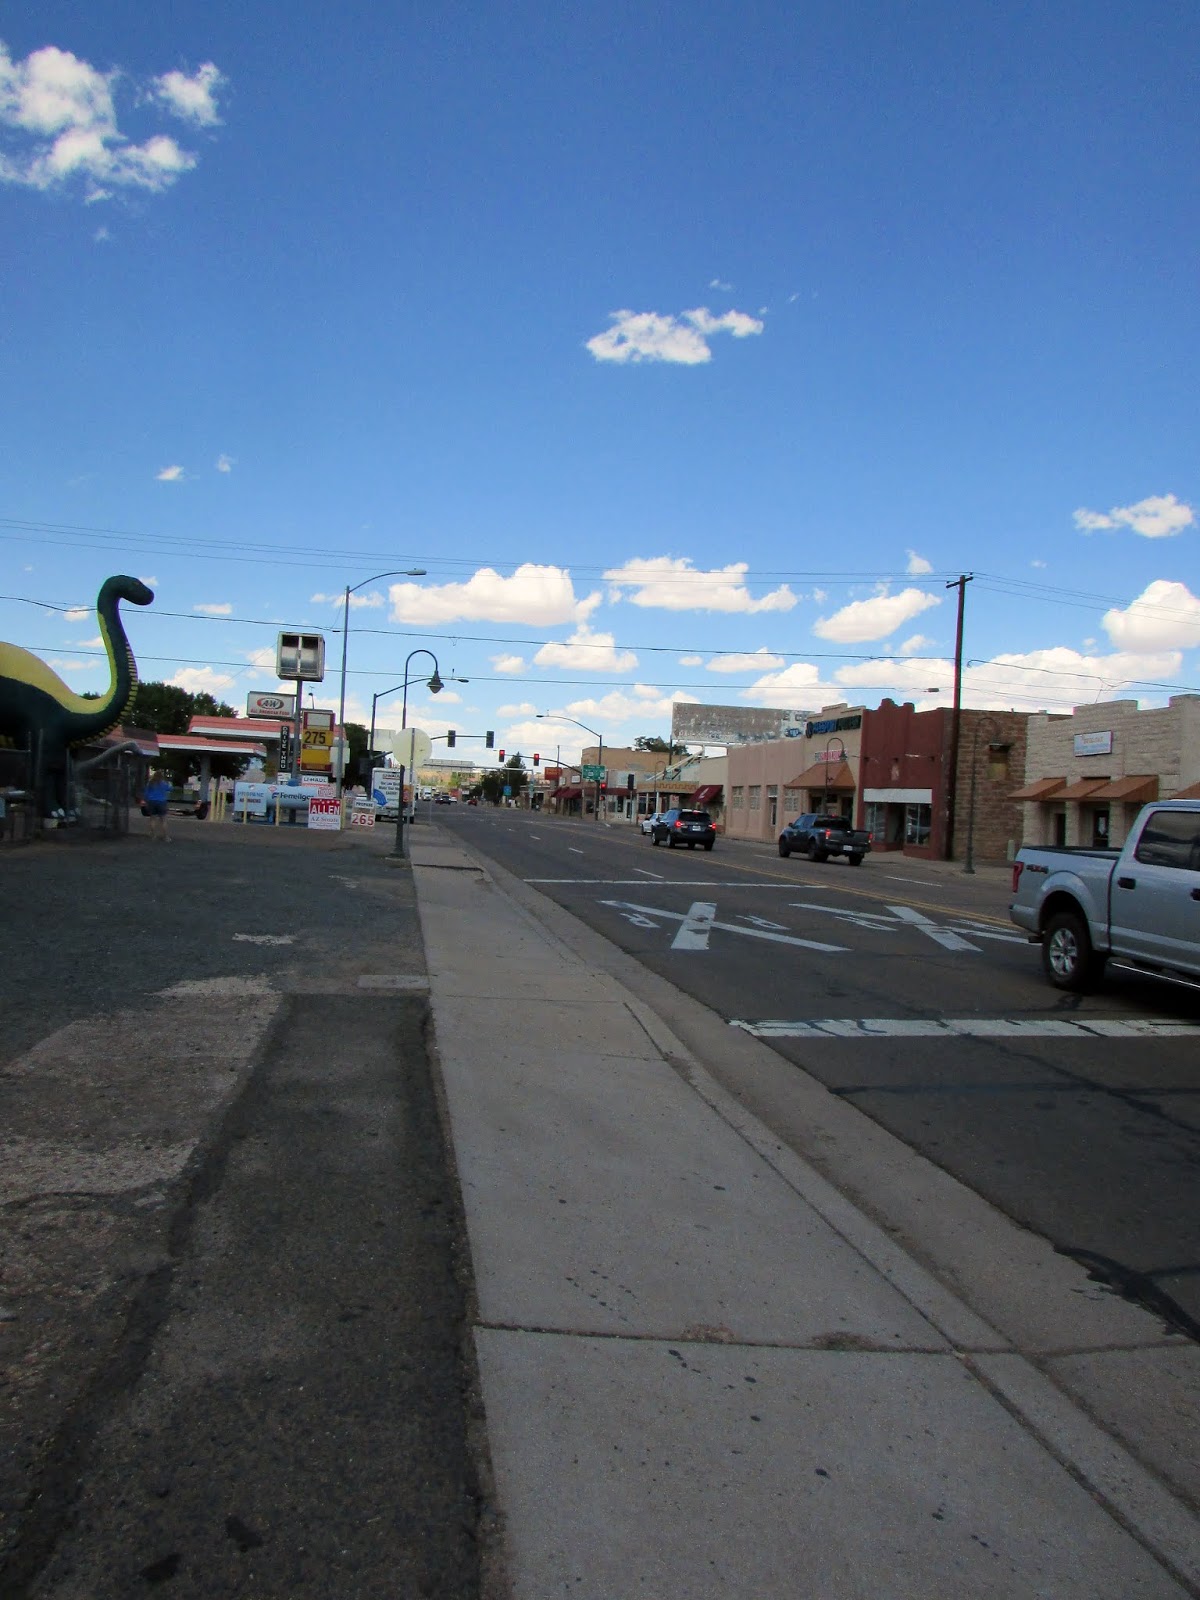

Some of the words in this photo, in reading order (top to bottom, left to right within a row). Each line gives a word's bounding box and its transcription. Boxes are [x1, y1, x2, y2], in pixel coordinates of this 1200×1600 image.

[304, 730, 326, 744] 275
[280, 792, 314, 801] Ferrellga
[310, 805, 340, 815] ALLEN
[352, 813, 374, 826] 265
